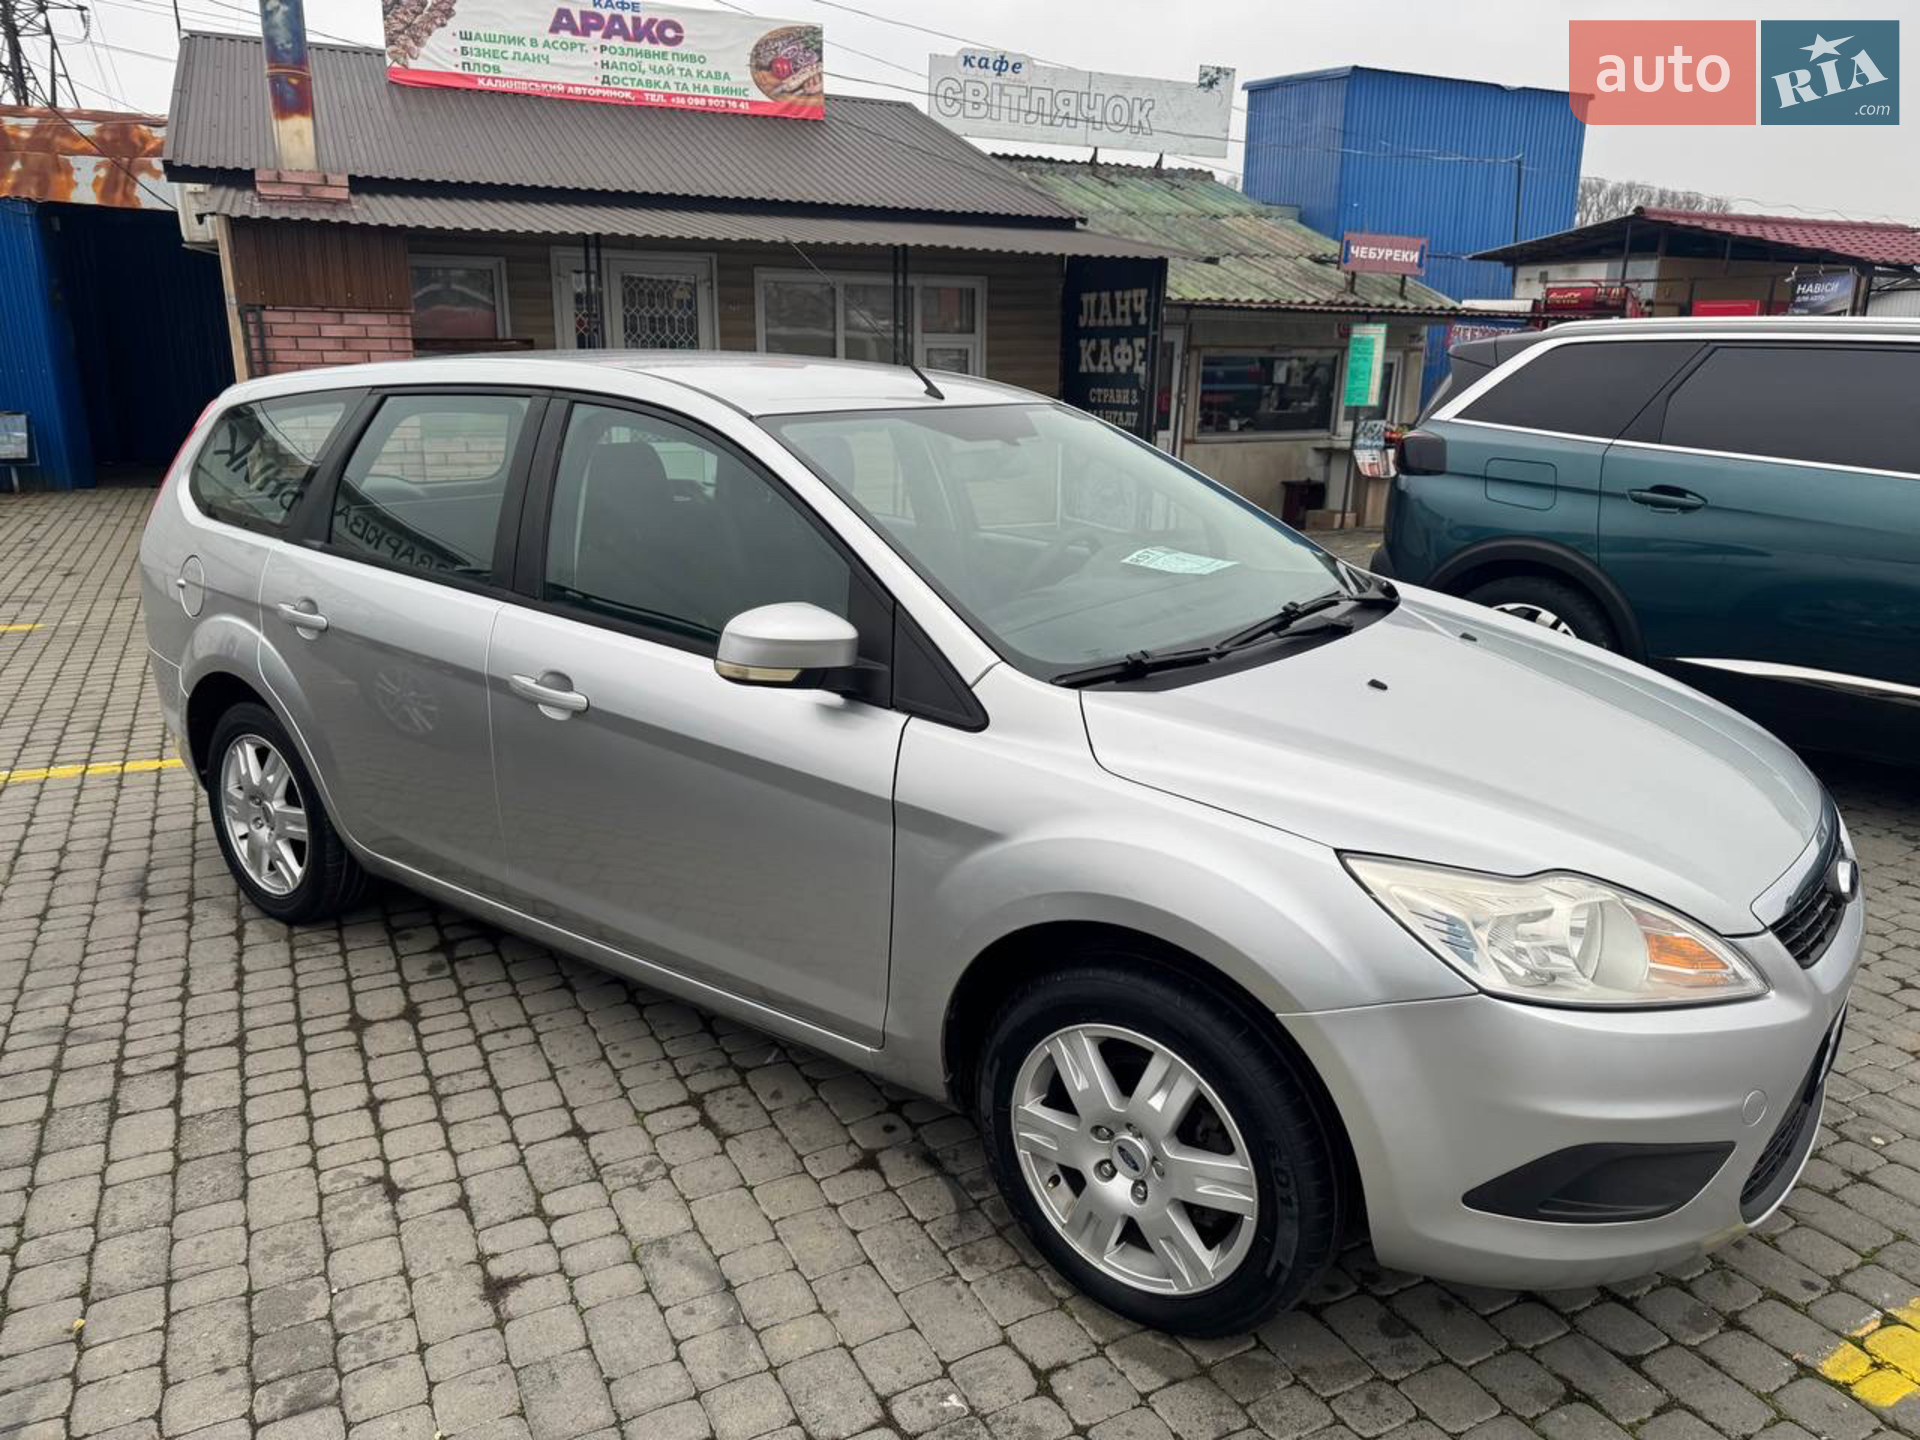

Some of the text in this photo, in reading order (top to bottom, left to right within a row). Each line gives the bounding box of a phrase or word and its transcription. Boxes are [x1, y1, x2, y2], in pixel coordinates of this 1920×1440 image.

[592, 0, 641, 13] КАФЕ
[548, 7, 685, 47] АРАКС
[459, 30, 589, 53] ШАШЛИК В АСОРТ.
[460, 46, 550, 64] БІЗНЕС ЛАНЧ
[600, 44, 707, 65] РОЗЛИВНЕ ПИВО
[962, 54, 1022, 76] кафе
[461, 61, 502, 74] ПЛОВ
[600, 60, 732, 81] НАПОЇ, ЧАЙ ТА КАВА
[601, 74, 750, 98] ДОСТАВКА ТА НА ВИНІС
[935, 76, 1156, 136] СВІТЛЯЧОК
[1350, 245, 1419, 263] ЧЕБУРЕКИ
[1079, 288, 1148, 327] ЛАНЧ
[1079, 337, 1147, 373] КАФЕ
[1089, 388, 1130, 404] СТРАВИ
